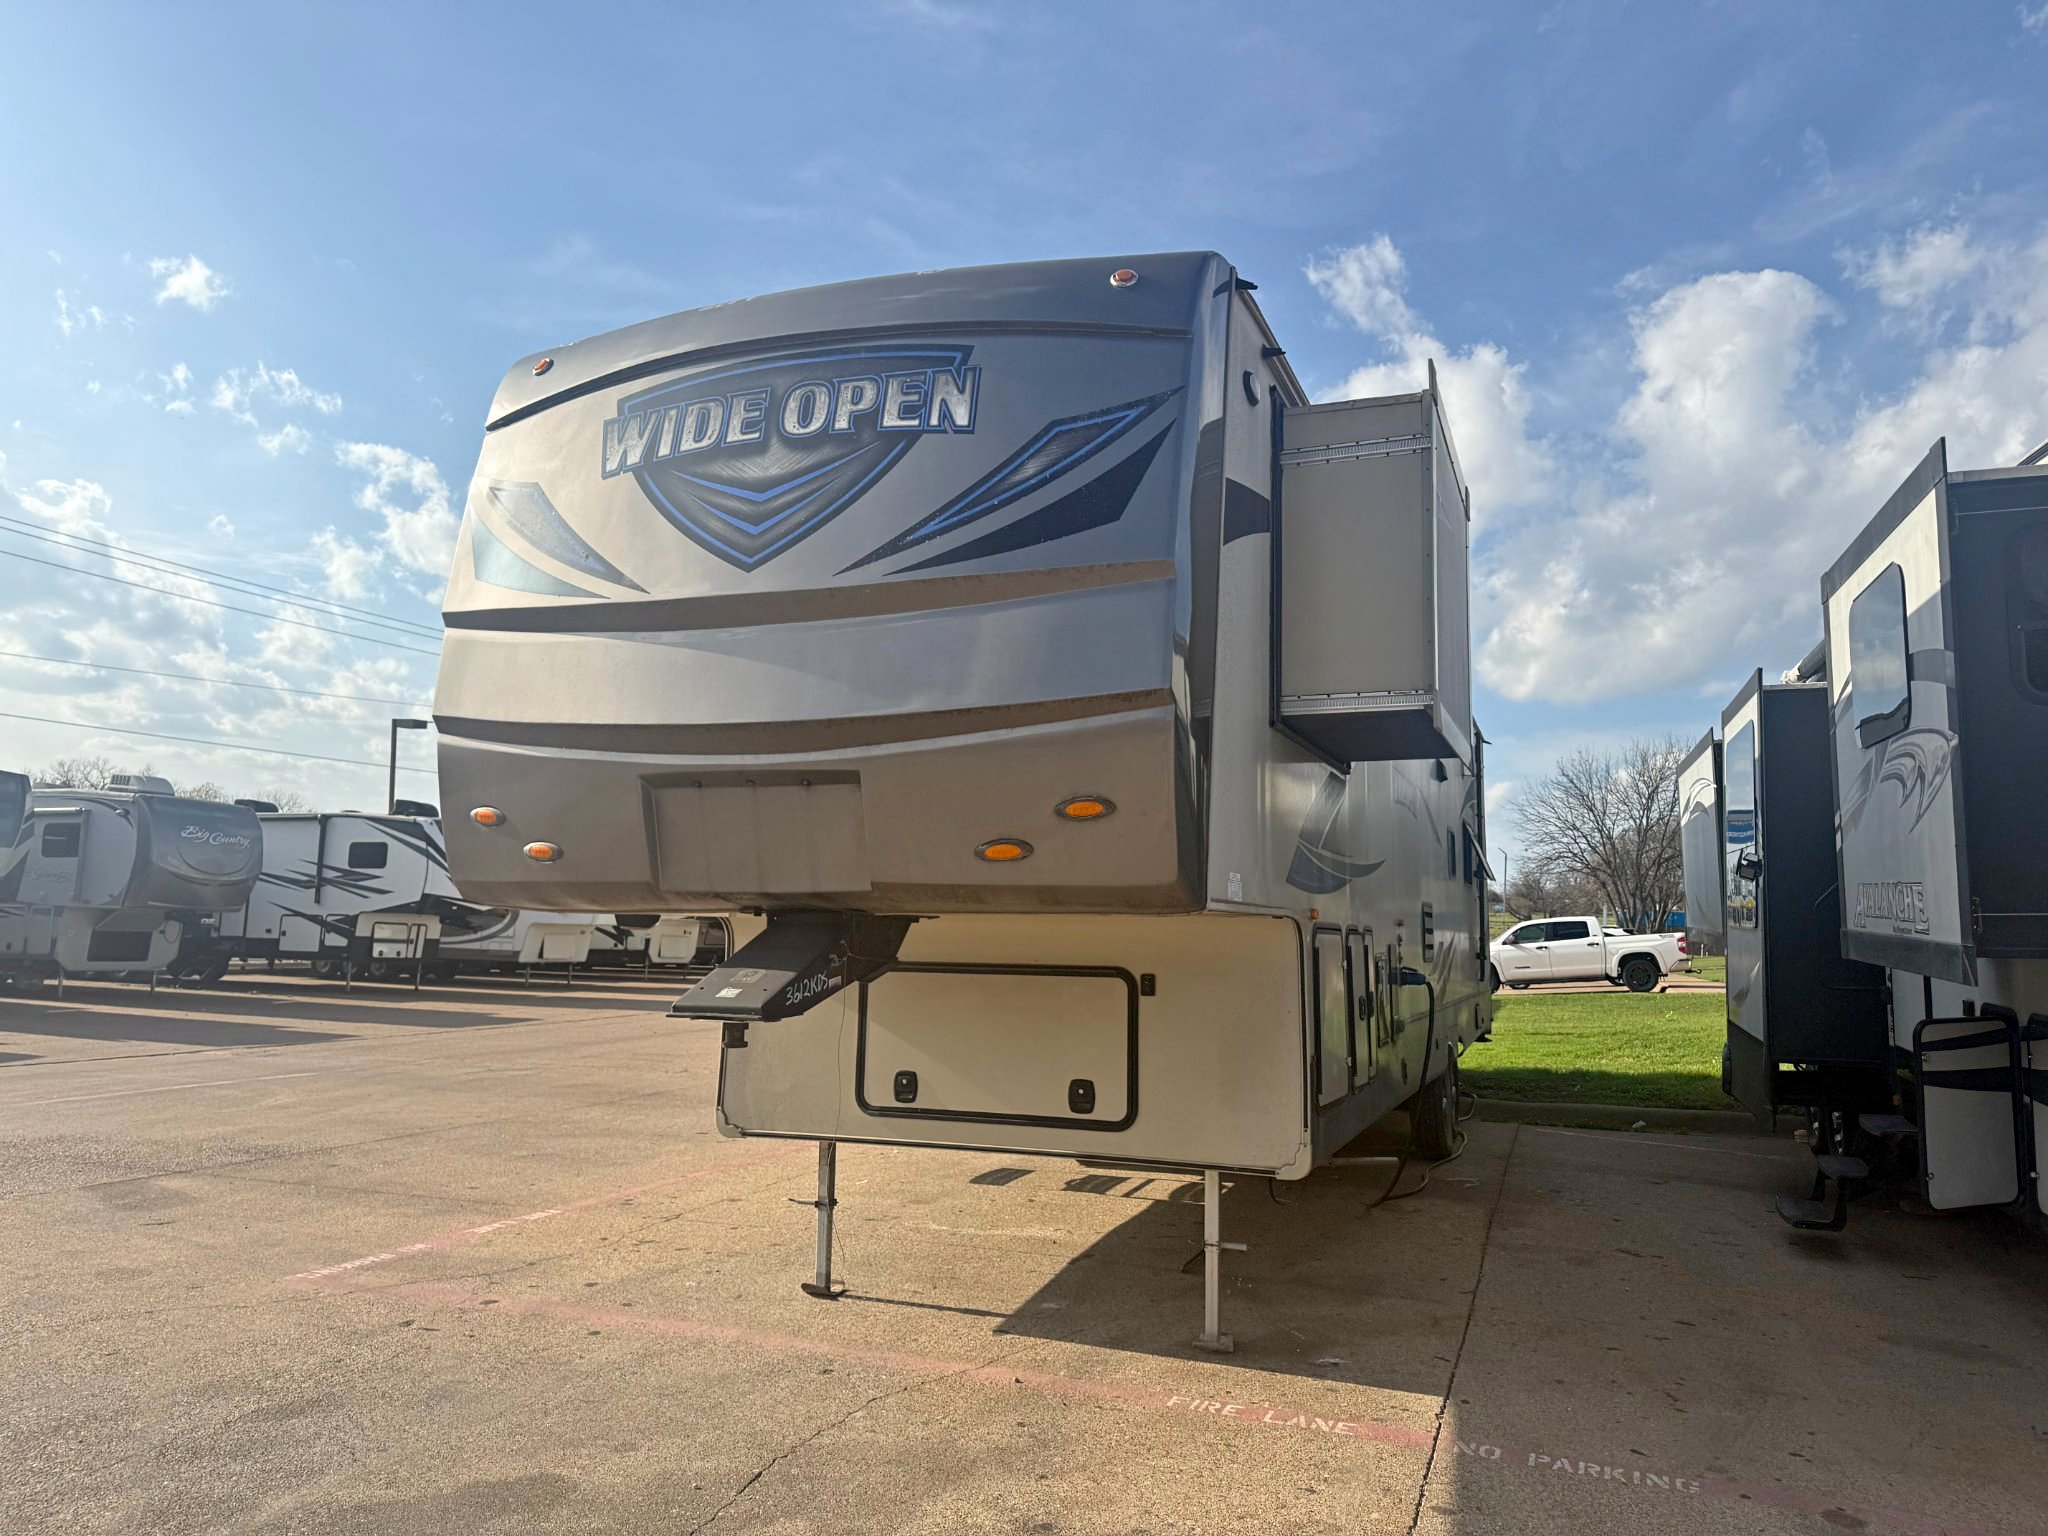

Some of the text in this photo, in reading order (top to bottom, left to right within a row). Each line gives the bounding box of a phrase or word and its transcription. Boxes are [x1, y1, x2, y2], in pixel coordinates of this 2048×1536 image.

[601, 365, 982, 479] WIDE OPEN
[181, 825, 250, 849] Big Country
[1853, 881, 1930, 936] AVALANCHE
[1165, 1395, 1358, 1436] FIRE LANE
[1454, 1440, 1700, 1494] NO PARKING
